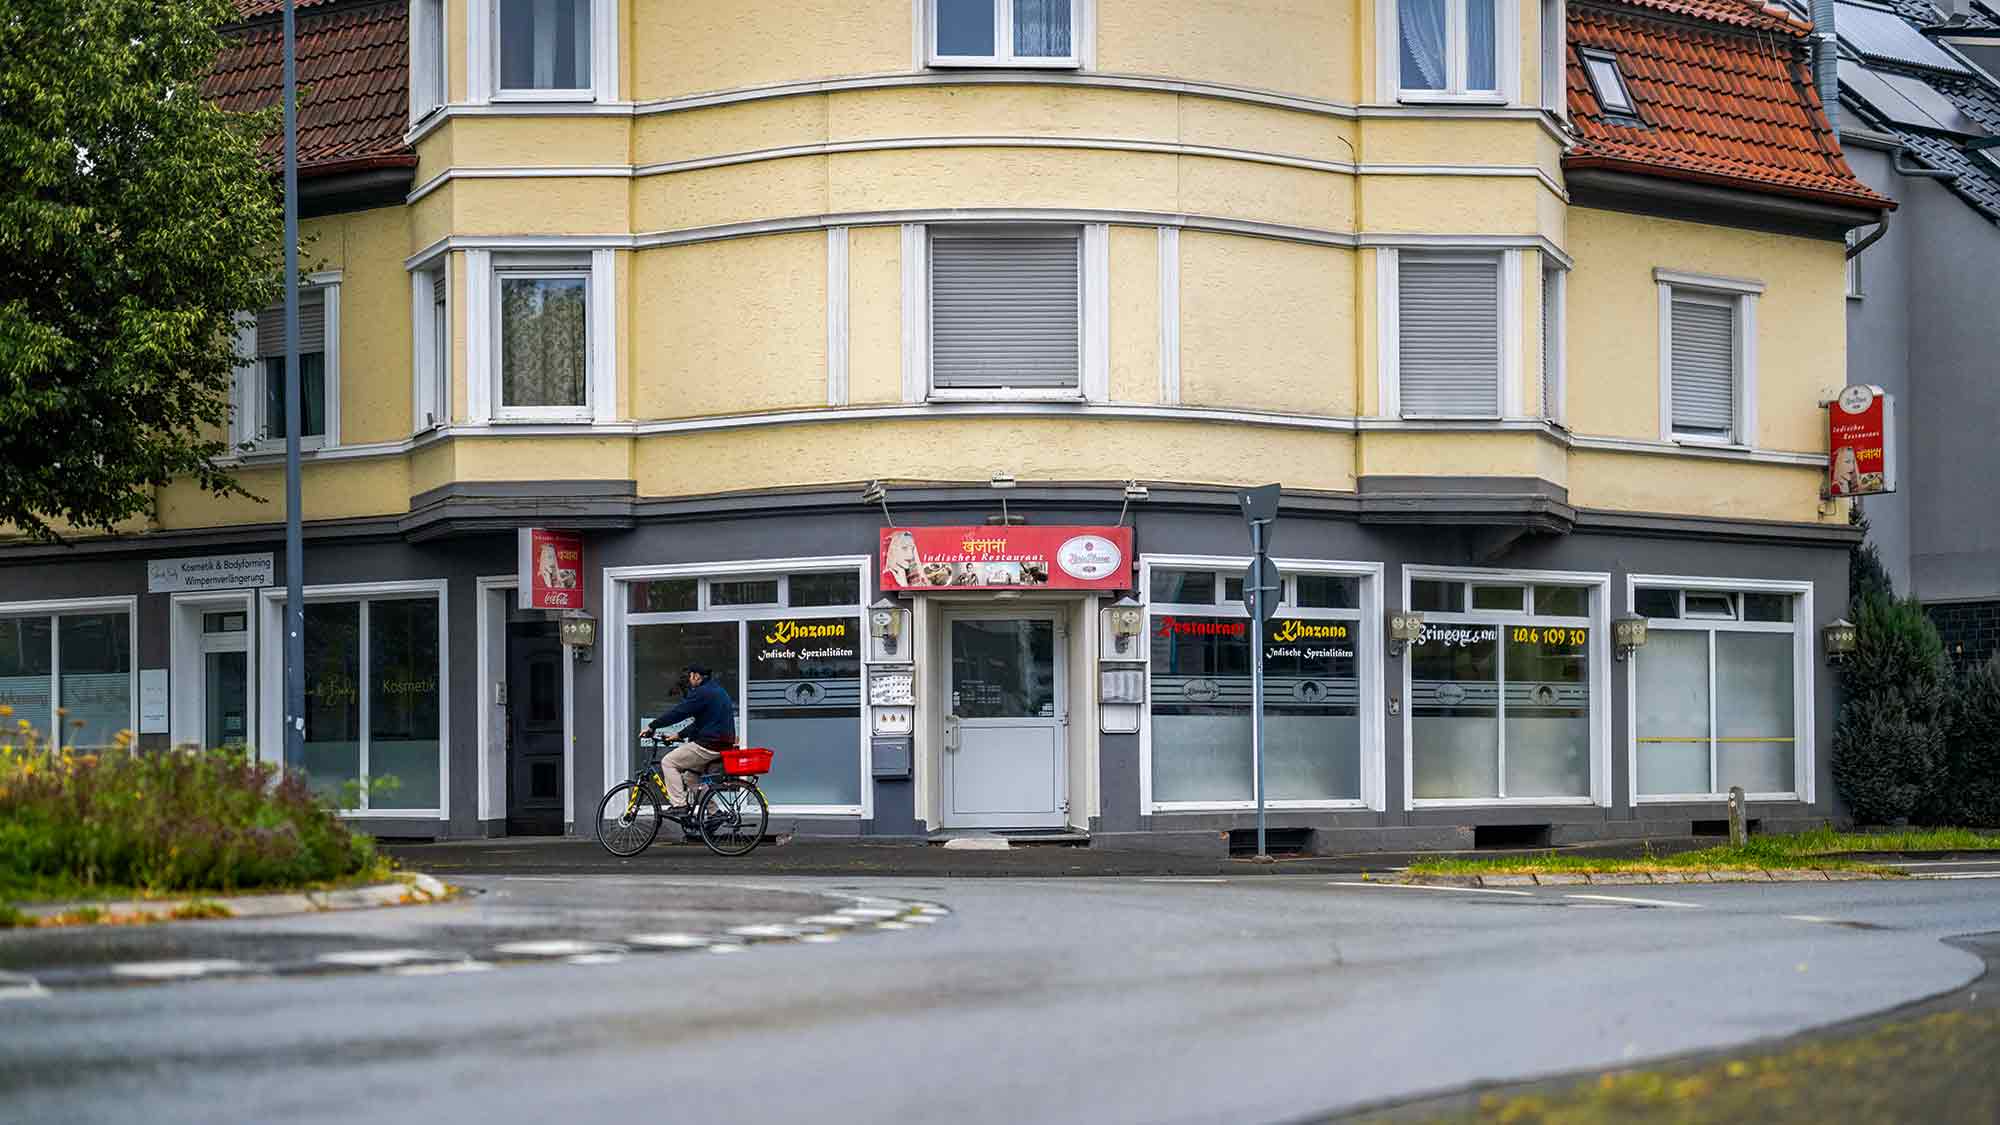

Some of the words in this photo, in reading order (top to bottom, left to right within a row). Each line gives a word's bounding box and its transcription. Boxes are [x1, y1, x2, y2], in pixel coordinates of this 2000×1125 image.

[923, 553, 977, 561] Indisches
[981, 552, 1044, 561] Restaurant
[181, 561, 213, 573] Kosmetik
[215, 560, 223, 570] &
[223, 558, 271, 571] Bodyforming
[184, 574, 265, 588] Wimpernverlängerung
[765, 619, 845, 644] Khazana
[1273, 619, 1346, 641] Khazana
[758, 649, 796, 661] Indische
[798, 647, 853, 660] Spezialitäten
[1266, 647, 1302, 659] Indische
[1304, 647, 1354, 660] Spezialitäten
